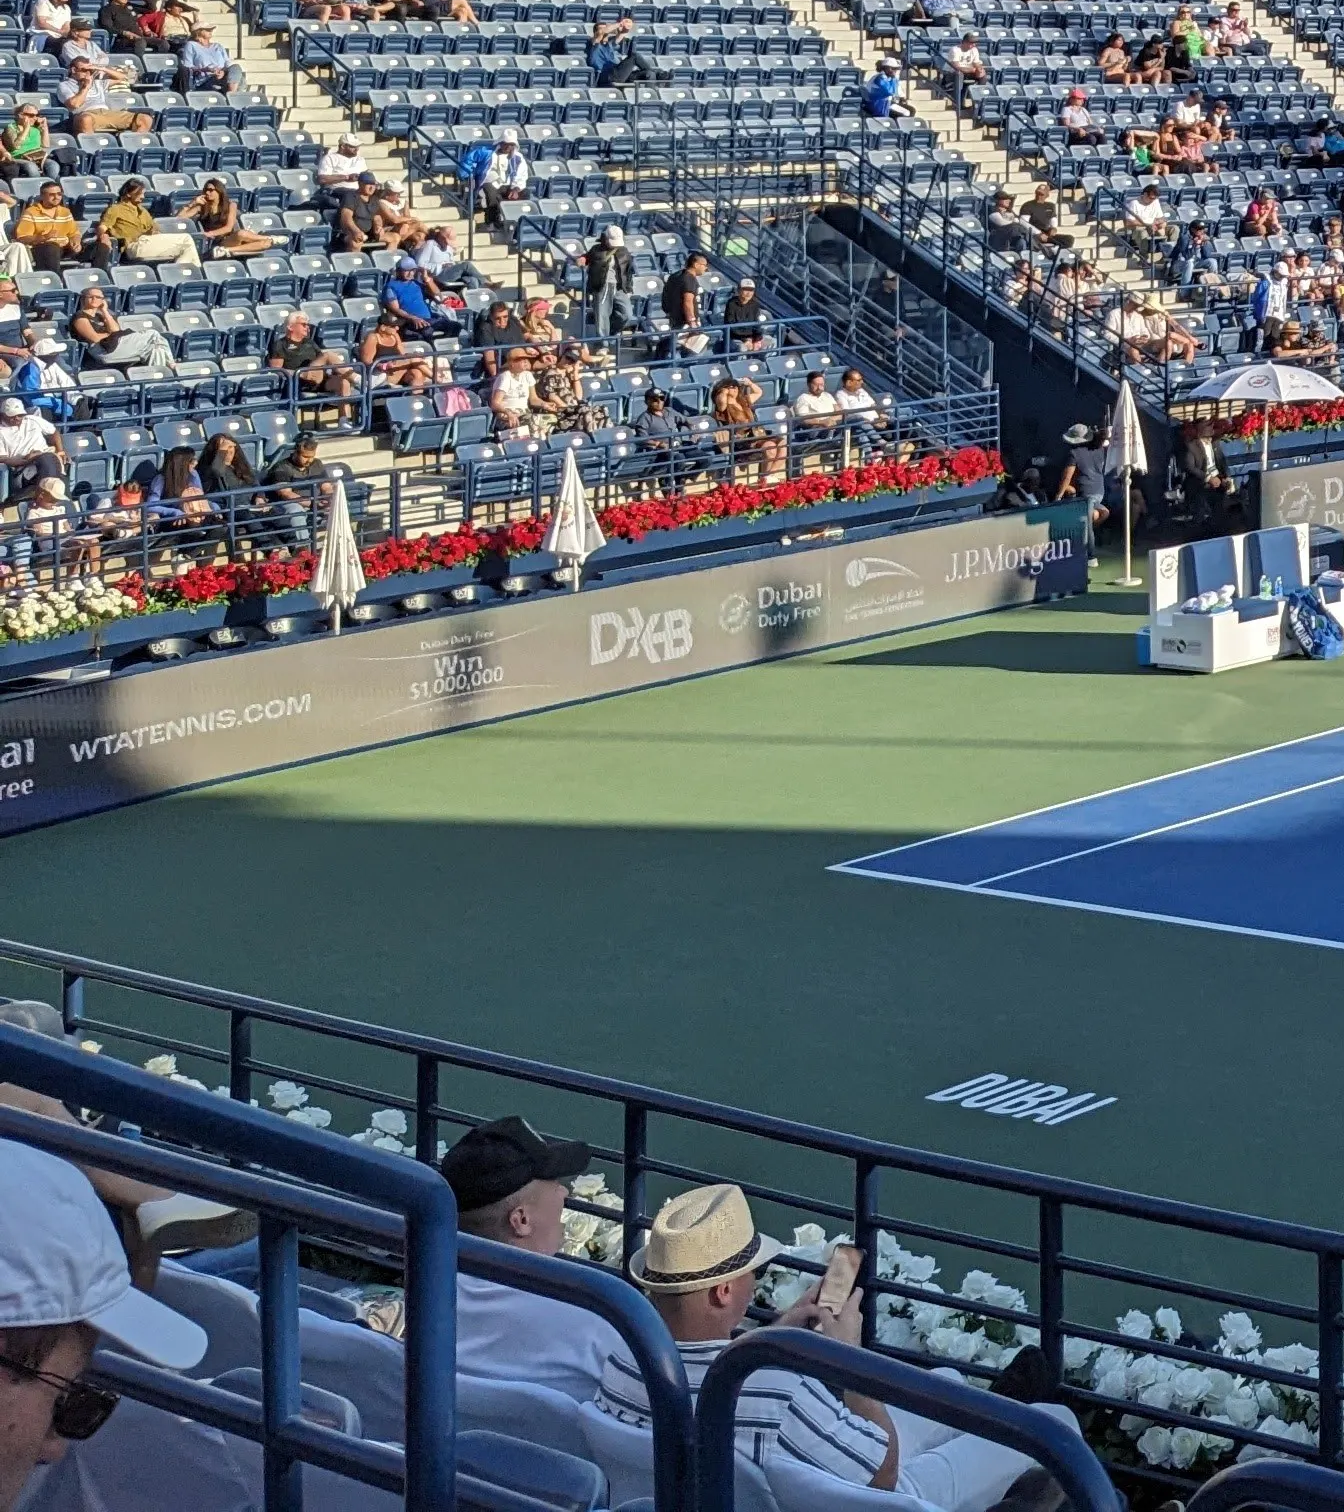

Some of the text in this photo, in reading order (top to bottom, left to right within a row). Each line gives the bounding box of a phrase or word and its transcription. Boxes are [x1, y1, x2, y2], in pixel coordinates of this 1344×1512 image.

[945, 538, 1073, 583] J.P.Morgan
[353, 608, 371, 618] EA7
[757, 582, 821, 609] Dubai
[758, 605, 821, 628] Duty Free
[590, 605, 693, 666] DXB
[433, 651, 483, 678] Win
[409, 666, 504, 701] $1,000,000
[69, 693, 312, 764] WTATENNIS.COM
[924, 1072, 1119, 1125] DUBAI
